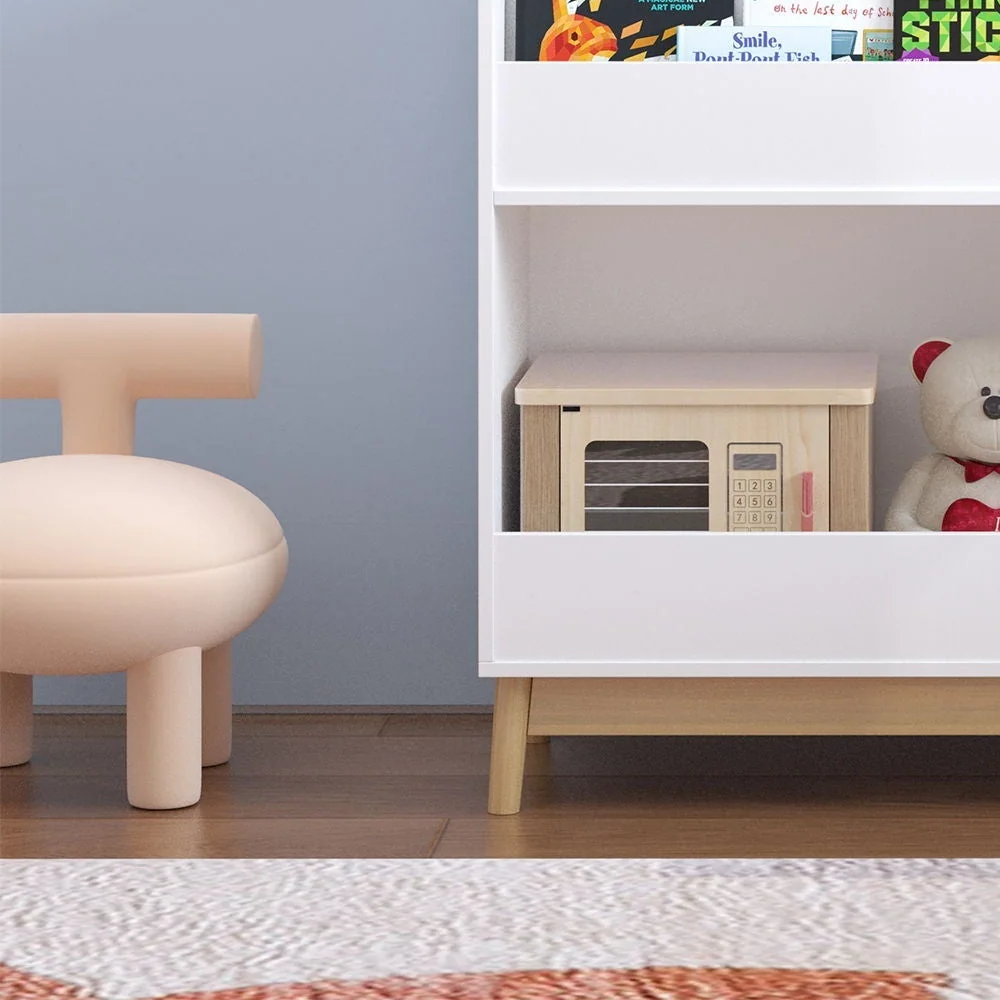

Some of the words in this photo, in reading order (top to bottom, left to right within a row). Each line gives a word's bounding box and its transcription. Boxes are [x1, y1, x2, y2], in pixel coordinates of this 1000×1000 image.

[790, 3, 808, 15] the
[813, 1, 835, 16] last
[841, 4, 858, 20] day
[862, 7, 875, 19] of
[732, 30, 782, 50] Smile,
